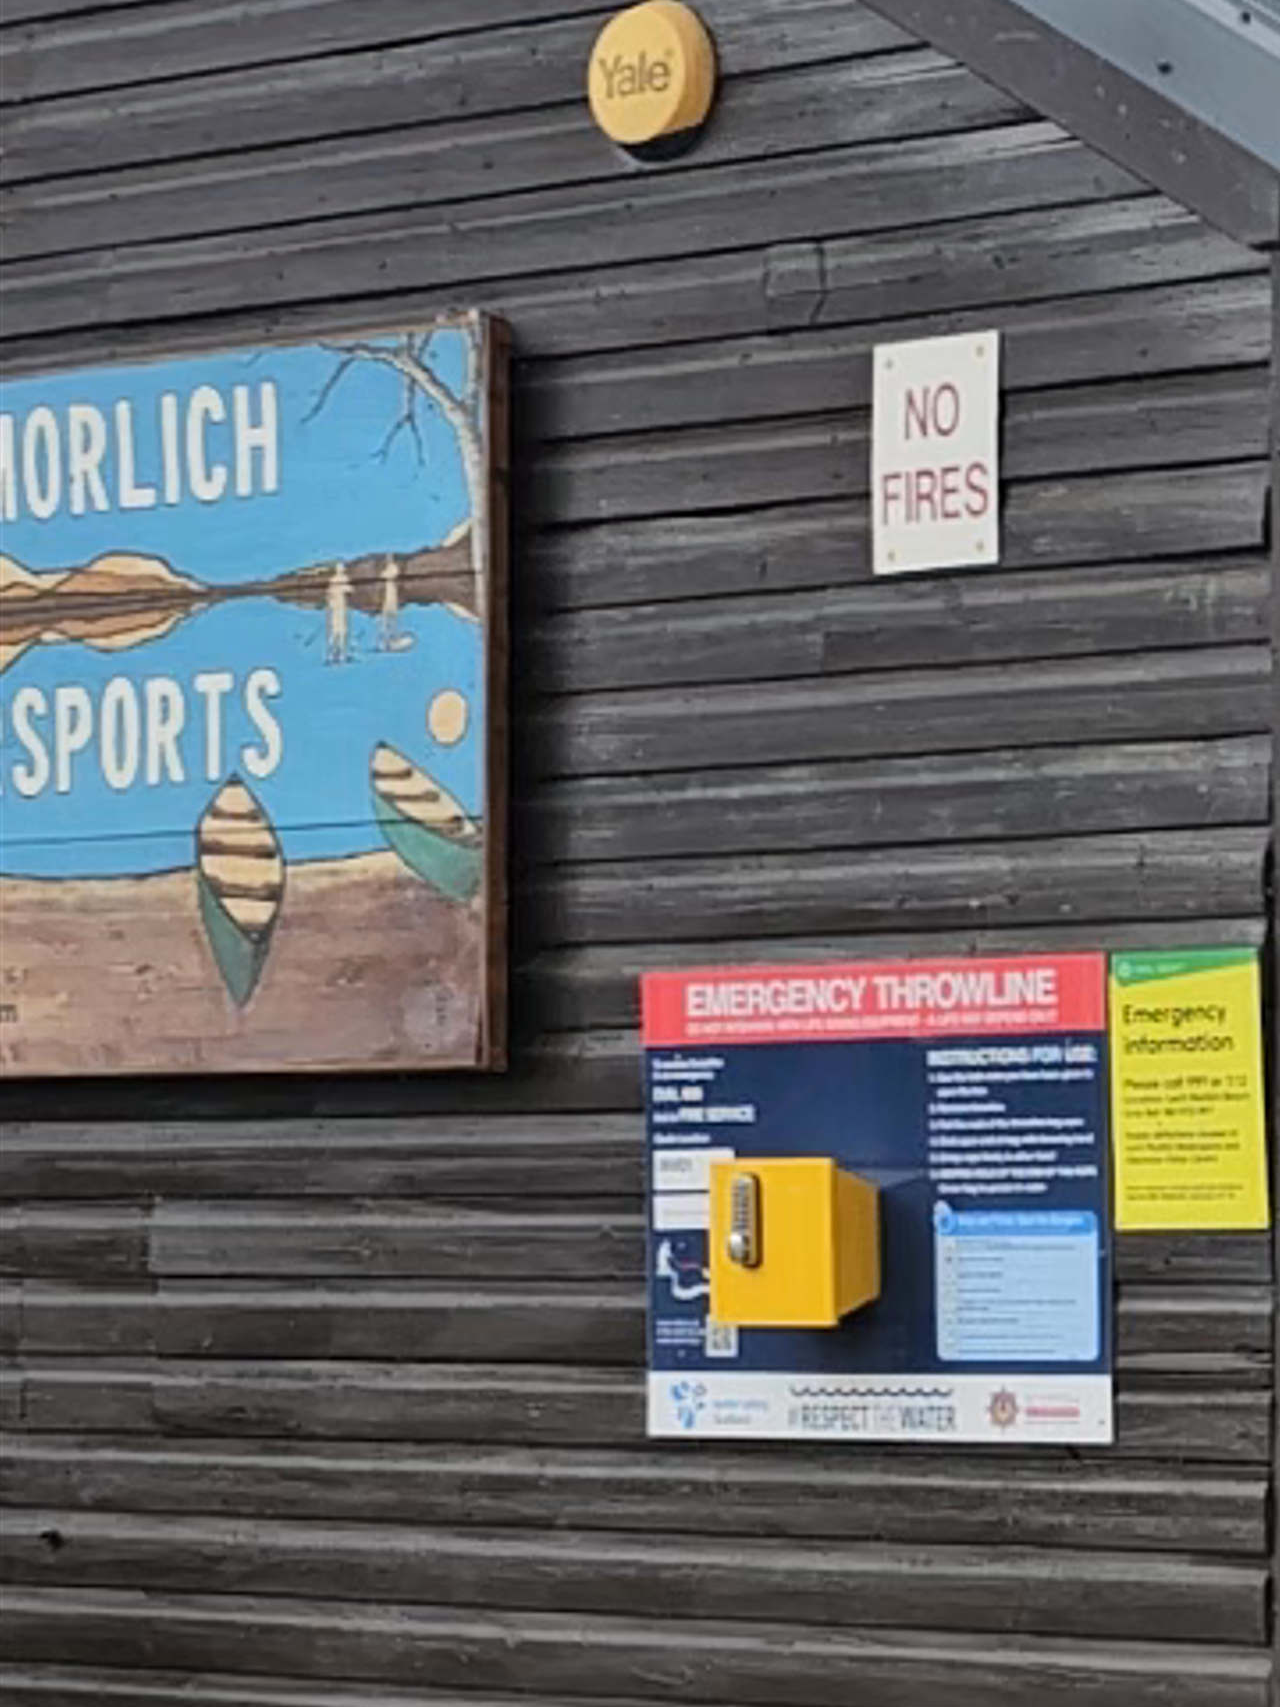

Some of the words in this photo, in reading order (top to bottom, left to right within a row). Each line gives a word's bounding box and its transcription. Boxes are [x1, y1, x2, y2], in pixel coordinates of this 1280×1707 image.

[597, 48, 671, 99] Yale
[902, 381, 961, 441] NO
[881, 462, 990, 527] FIRES
[11, 668, 283, 797] SPORTS
[687, 977, 867, 1017] EMERGENCY
[871, 968, 1059, 1010] THROWLINE
[1122, 1003, 1226, 1028] Emergency
[1122, 1033, 1235, 1055] information
